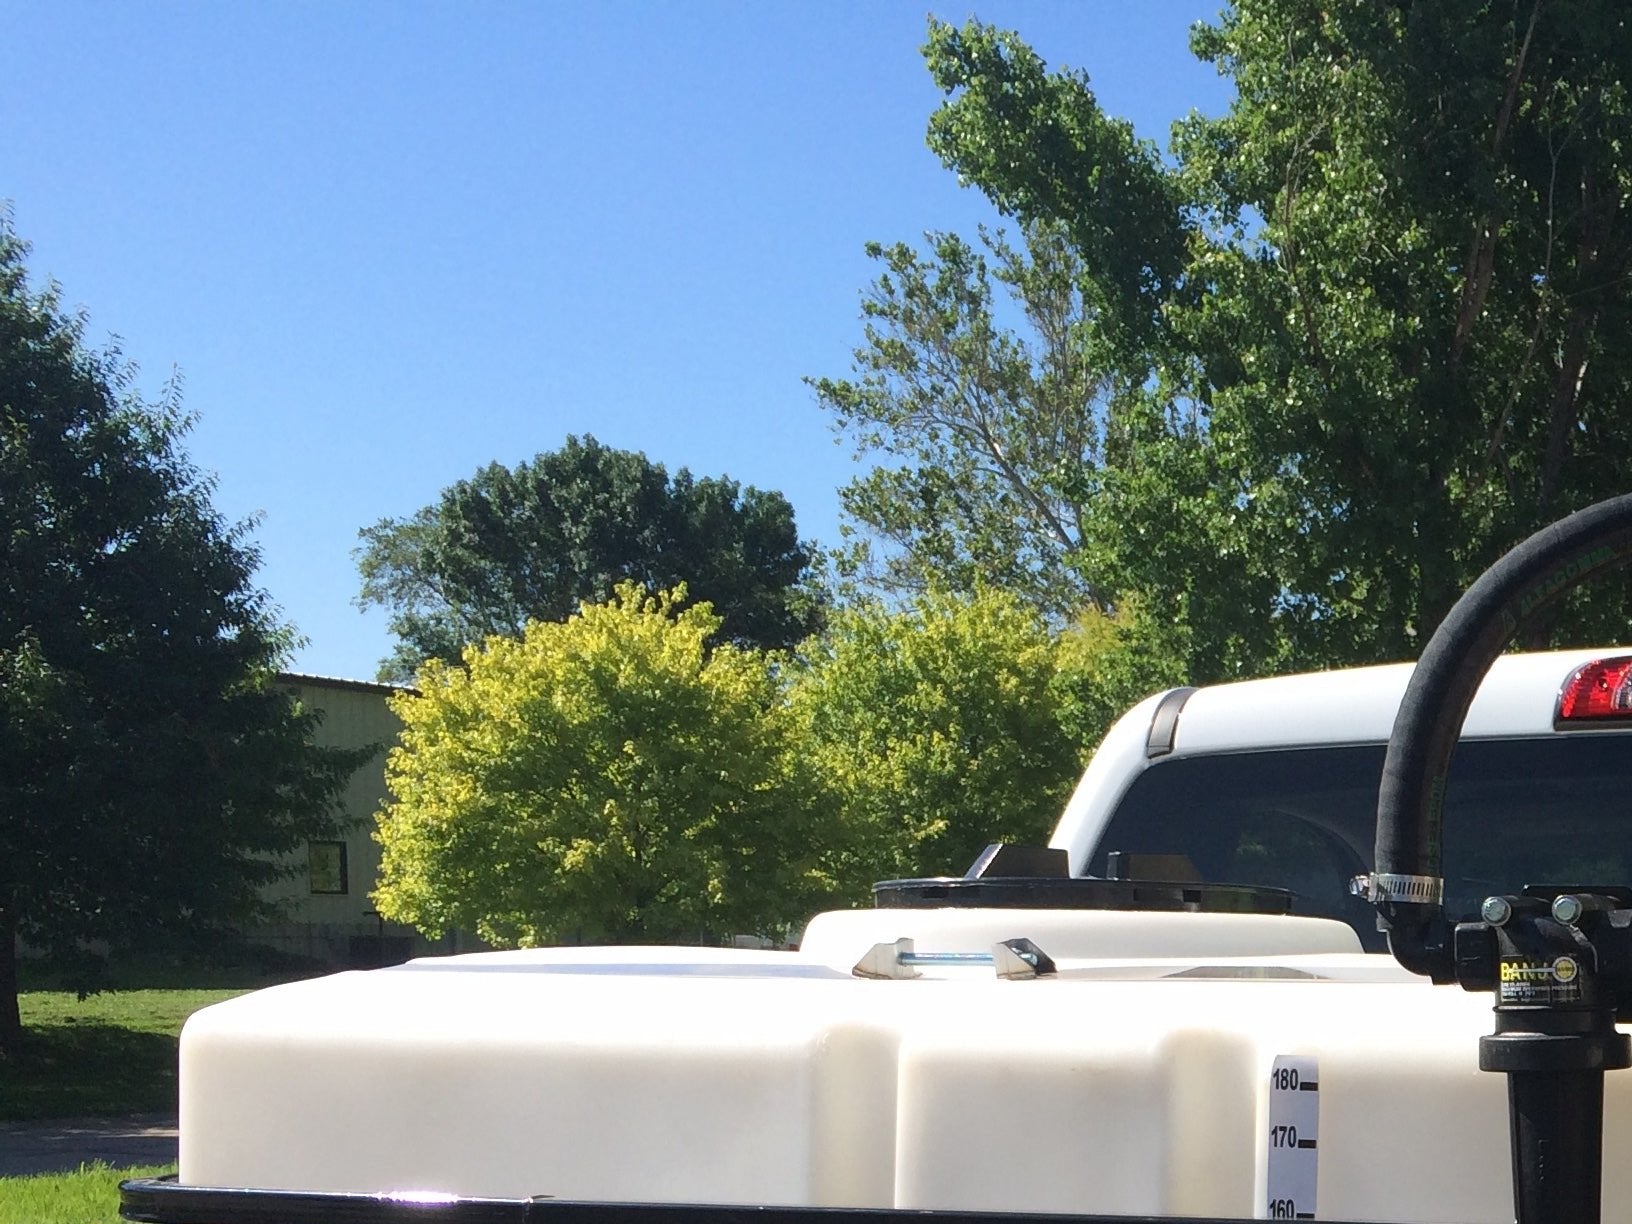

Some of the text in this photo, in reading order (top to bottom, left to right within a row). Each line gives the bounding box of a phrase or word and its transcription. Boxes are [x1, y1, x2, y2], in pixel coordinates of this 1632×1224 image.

[1273, 1068, 1298, 1091] 180
[1271, 1126, 1297, 1148] 170
[1269, 1199, 1294, 1219] 160
